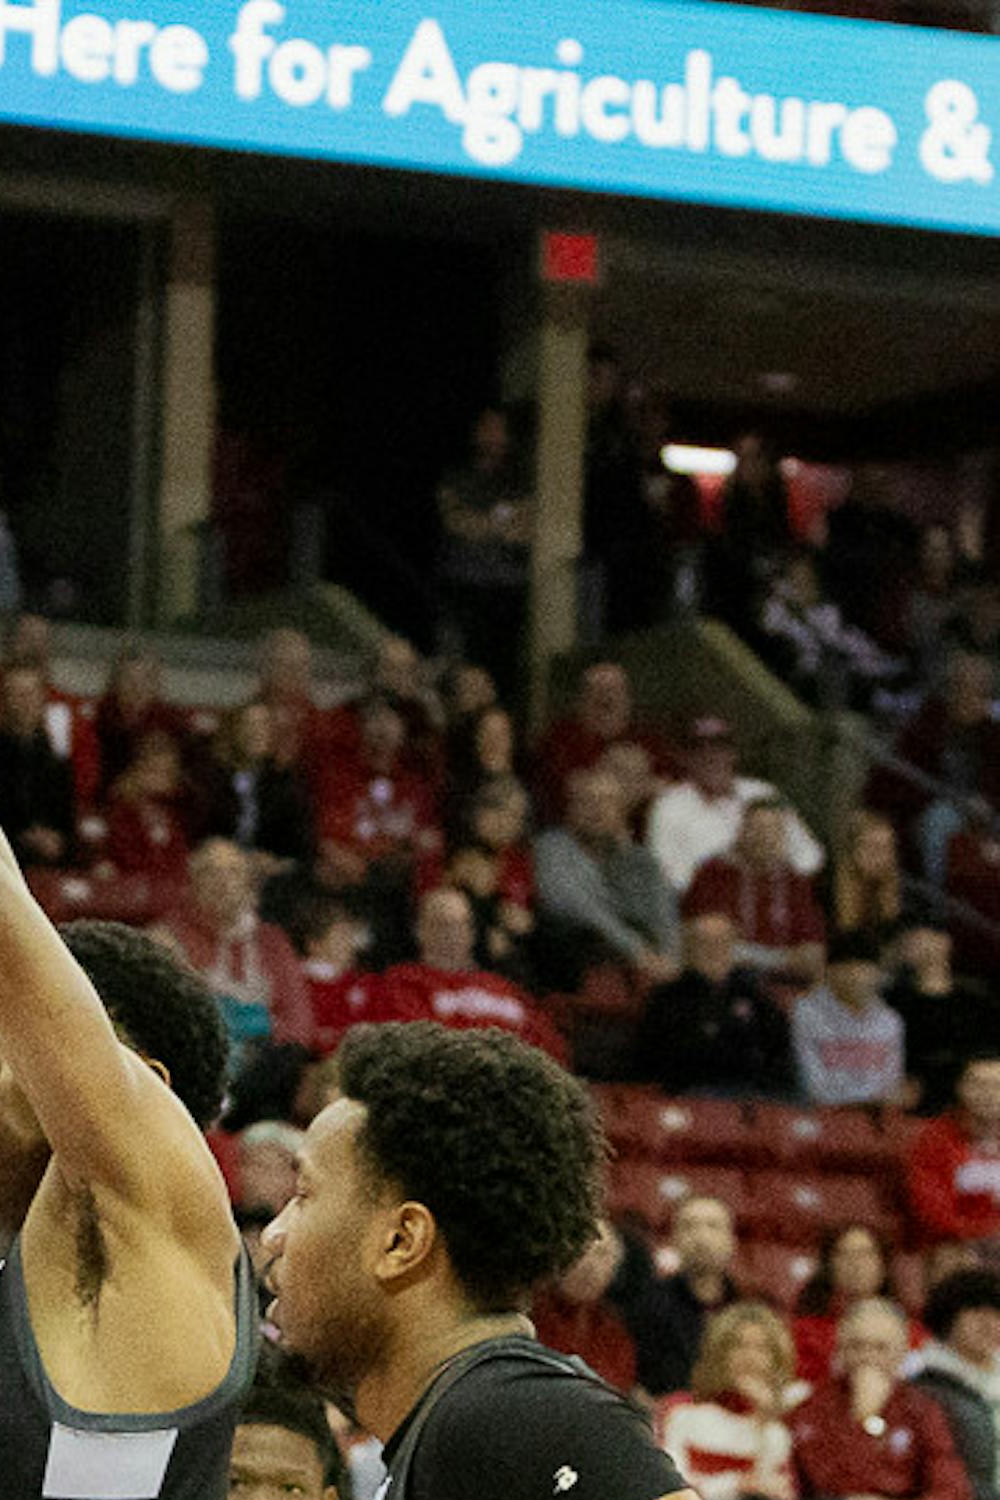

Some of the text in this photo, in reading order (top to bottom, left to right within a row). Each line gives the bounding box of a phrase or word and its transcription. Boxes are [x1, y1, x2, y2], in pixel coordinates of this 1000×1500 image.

[230, 0, 371, 110] for
[384, 18, 897, 167] Agriculture
[918, 79, 995, 184] &
